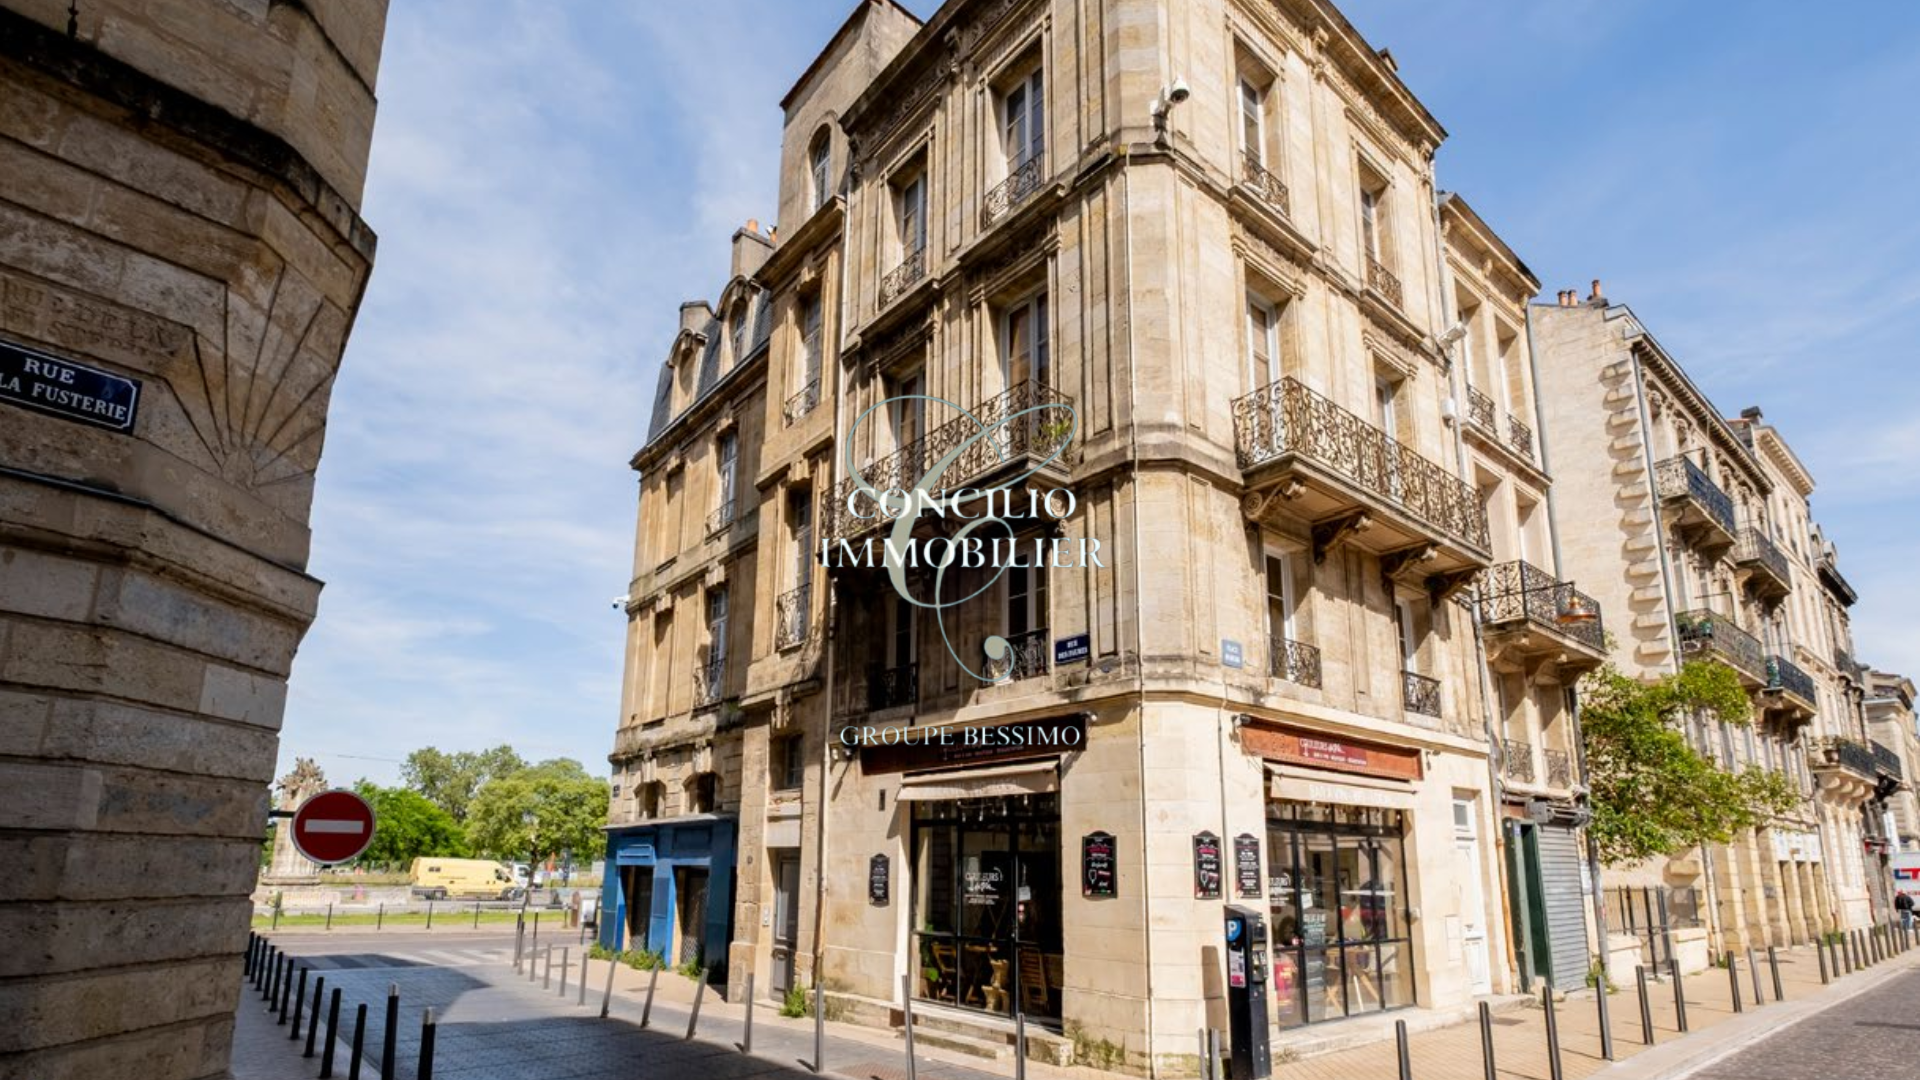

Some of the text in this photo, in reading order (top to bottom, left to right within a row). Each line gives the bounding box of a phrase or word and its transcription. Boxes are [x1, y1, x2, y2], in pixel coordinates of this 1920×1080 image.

[23, 358, 75, 385] RUE
[0, 372, 127, 421] LA FUSTERIE
[1227, 921, 1238, 937] P
